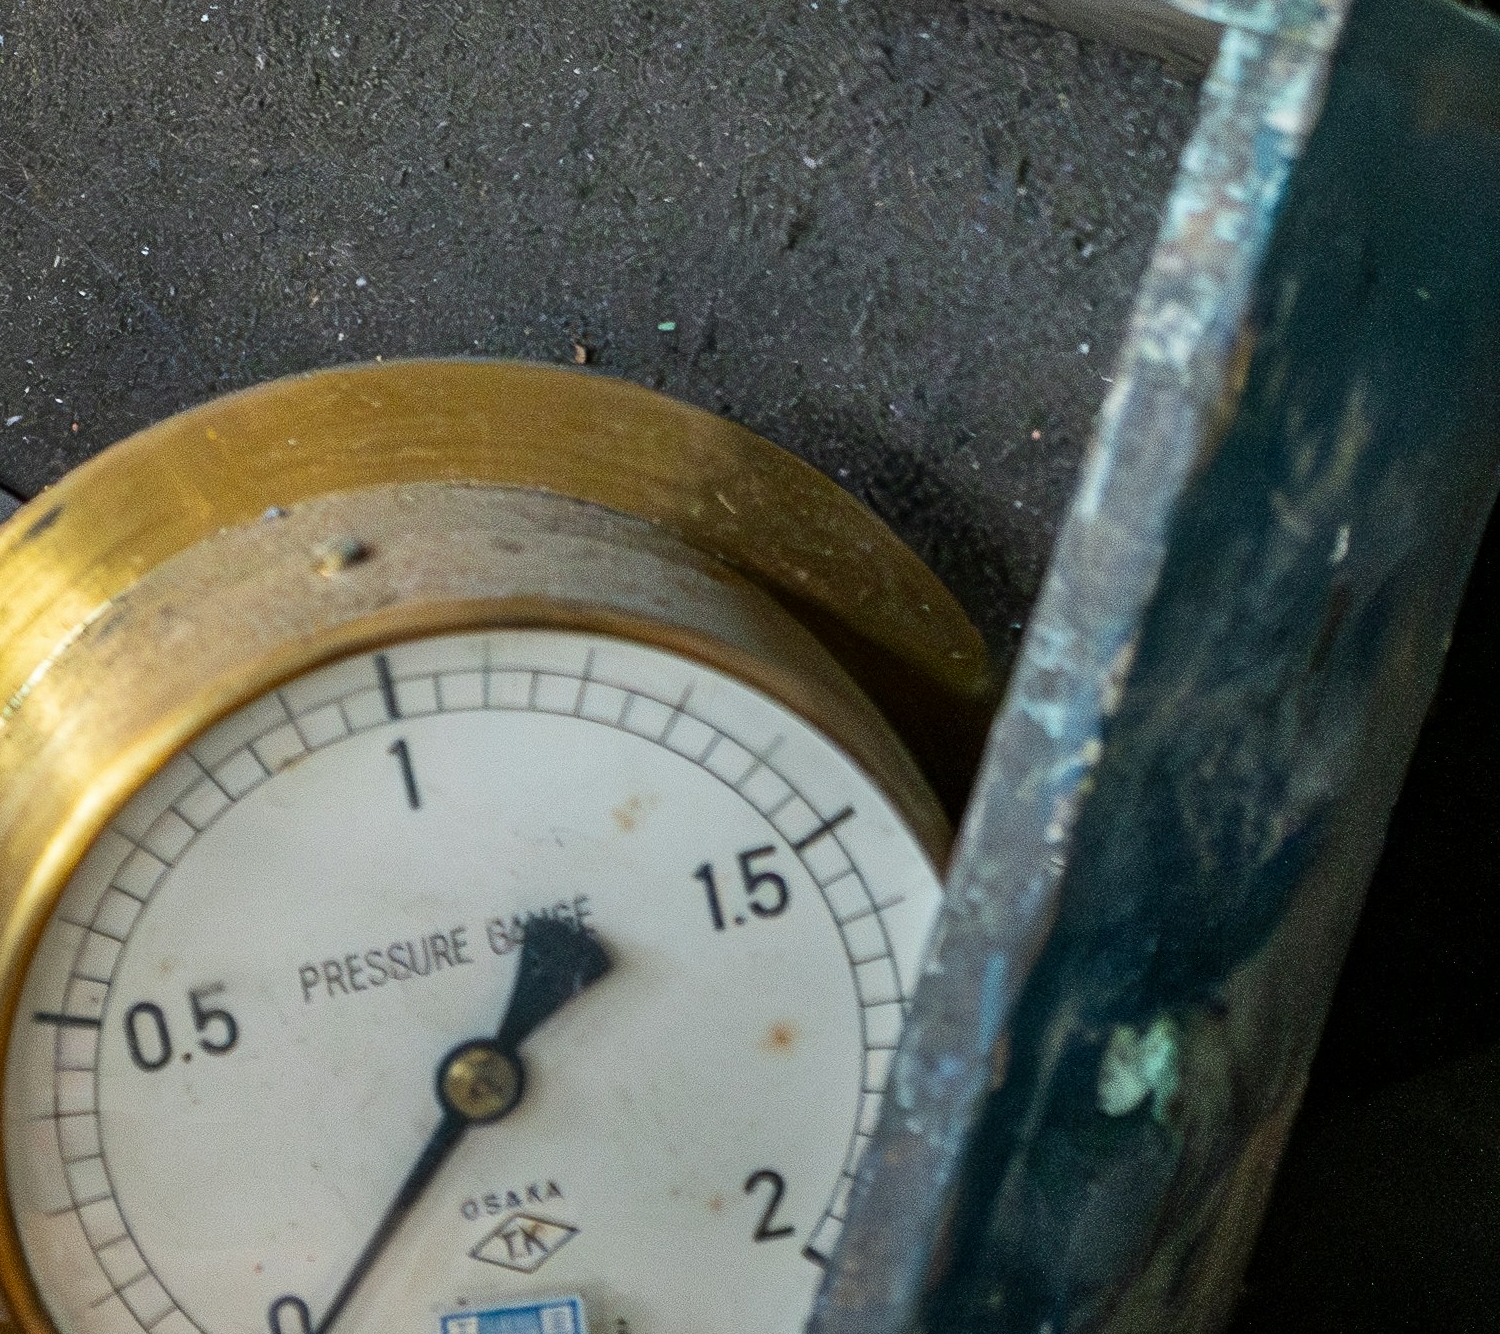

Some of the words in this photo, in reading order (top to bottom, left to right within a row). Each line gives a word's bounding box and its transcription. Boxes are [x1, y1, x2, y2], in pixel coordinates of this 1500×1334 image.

[388, 738, 423, 810] 1
[693, 846, 790, 932] 1.5
[299, 925, 471, 1002] PRESSURE
[124, 981, 240, 1072] 0.5
[461, 1179, 562, 1221] OSAKA
[743, 1169, 796, 1243] 2
